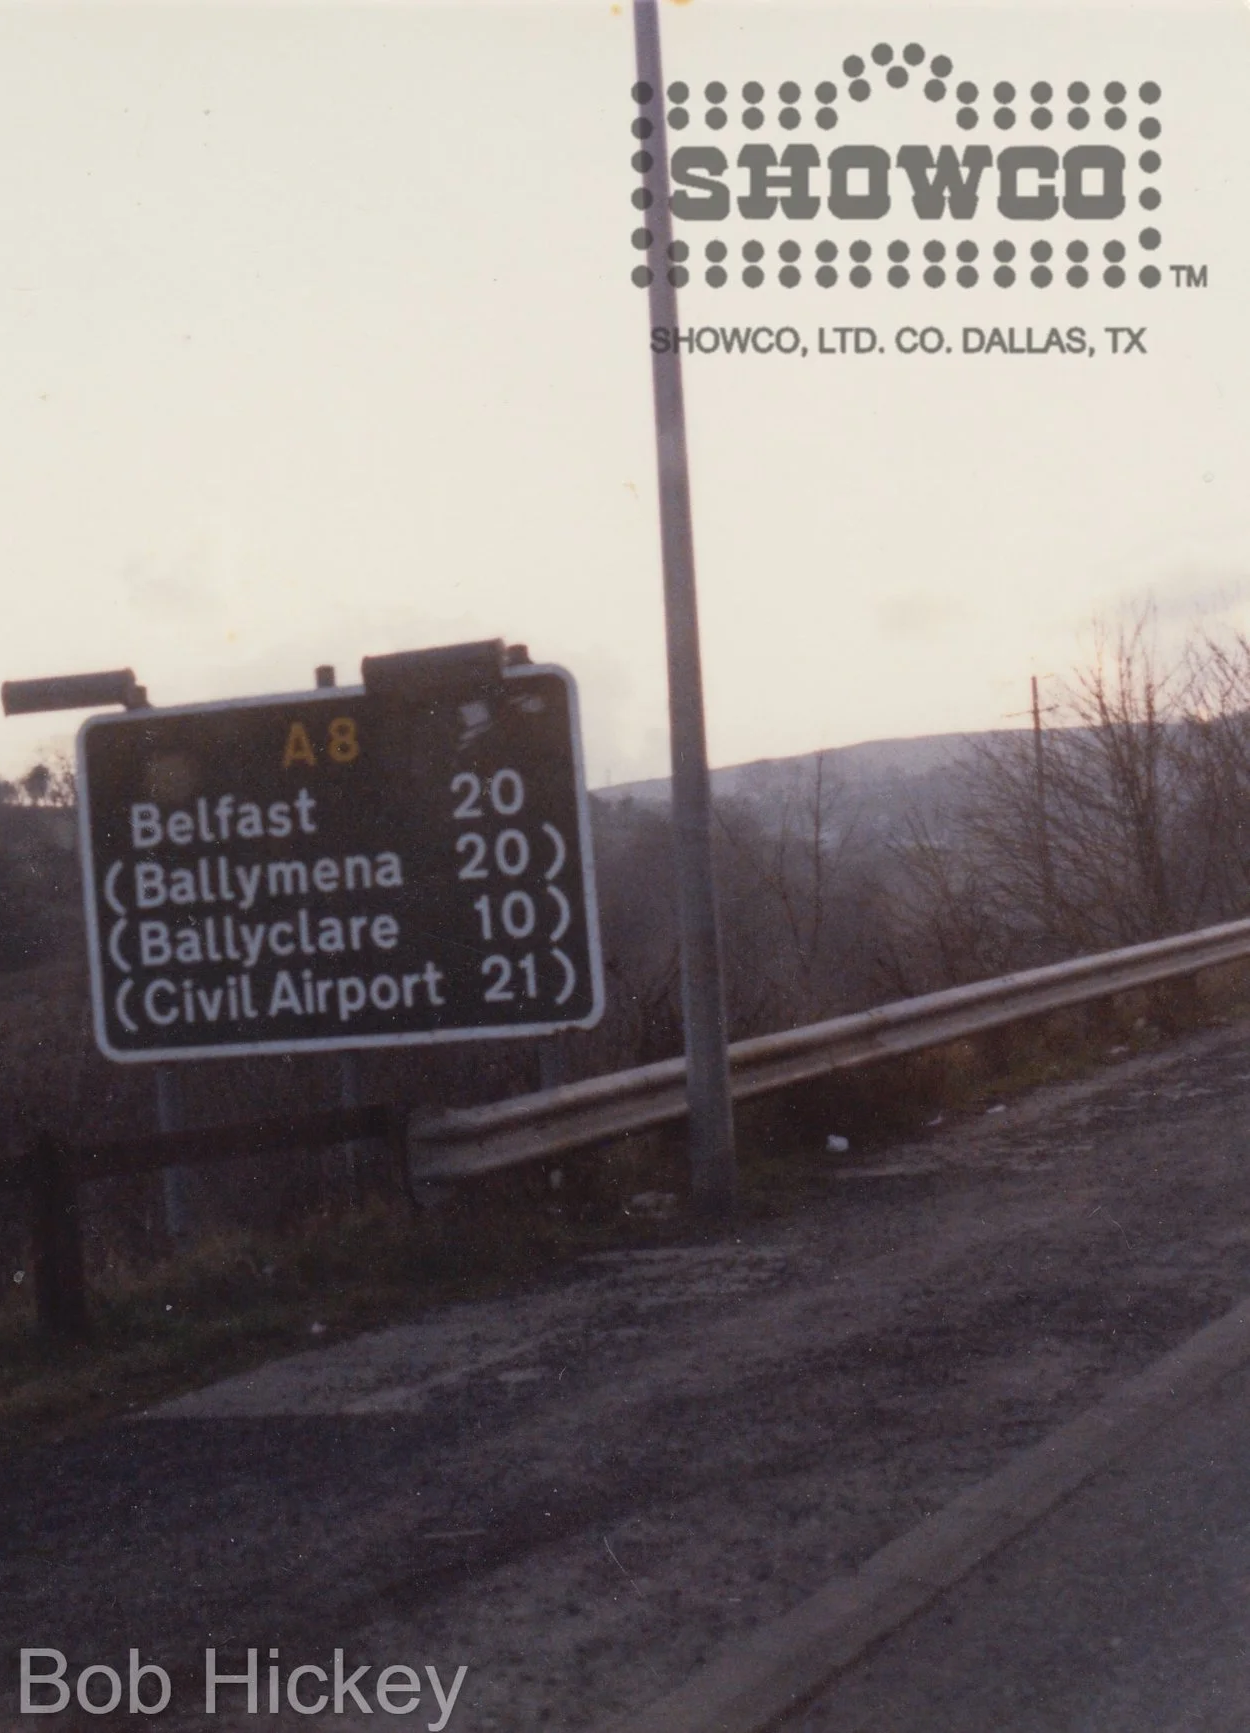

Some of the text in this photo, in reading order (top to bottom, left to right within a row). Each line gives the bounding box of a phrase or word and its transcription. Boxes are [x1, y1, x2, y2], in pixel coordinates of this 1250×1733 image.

[131, 769, 524, 848] Belfast 20
[105, 823, 566, 915] (Ballymena 20)
[110, 886, 570, 972] (Ballyclare 10)
[116, 948, 576, 1032] (Civil Airport 21)
